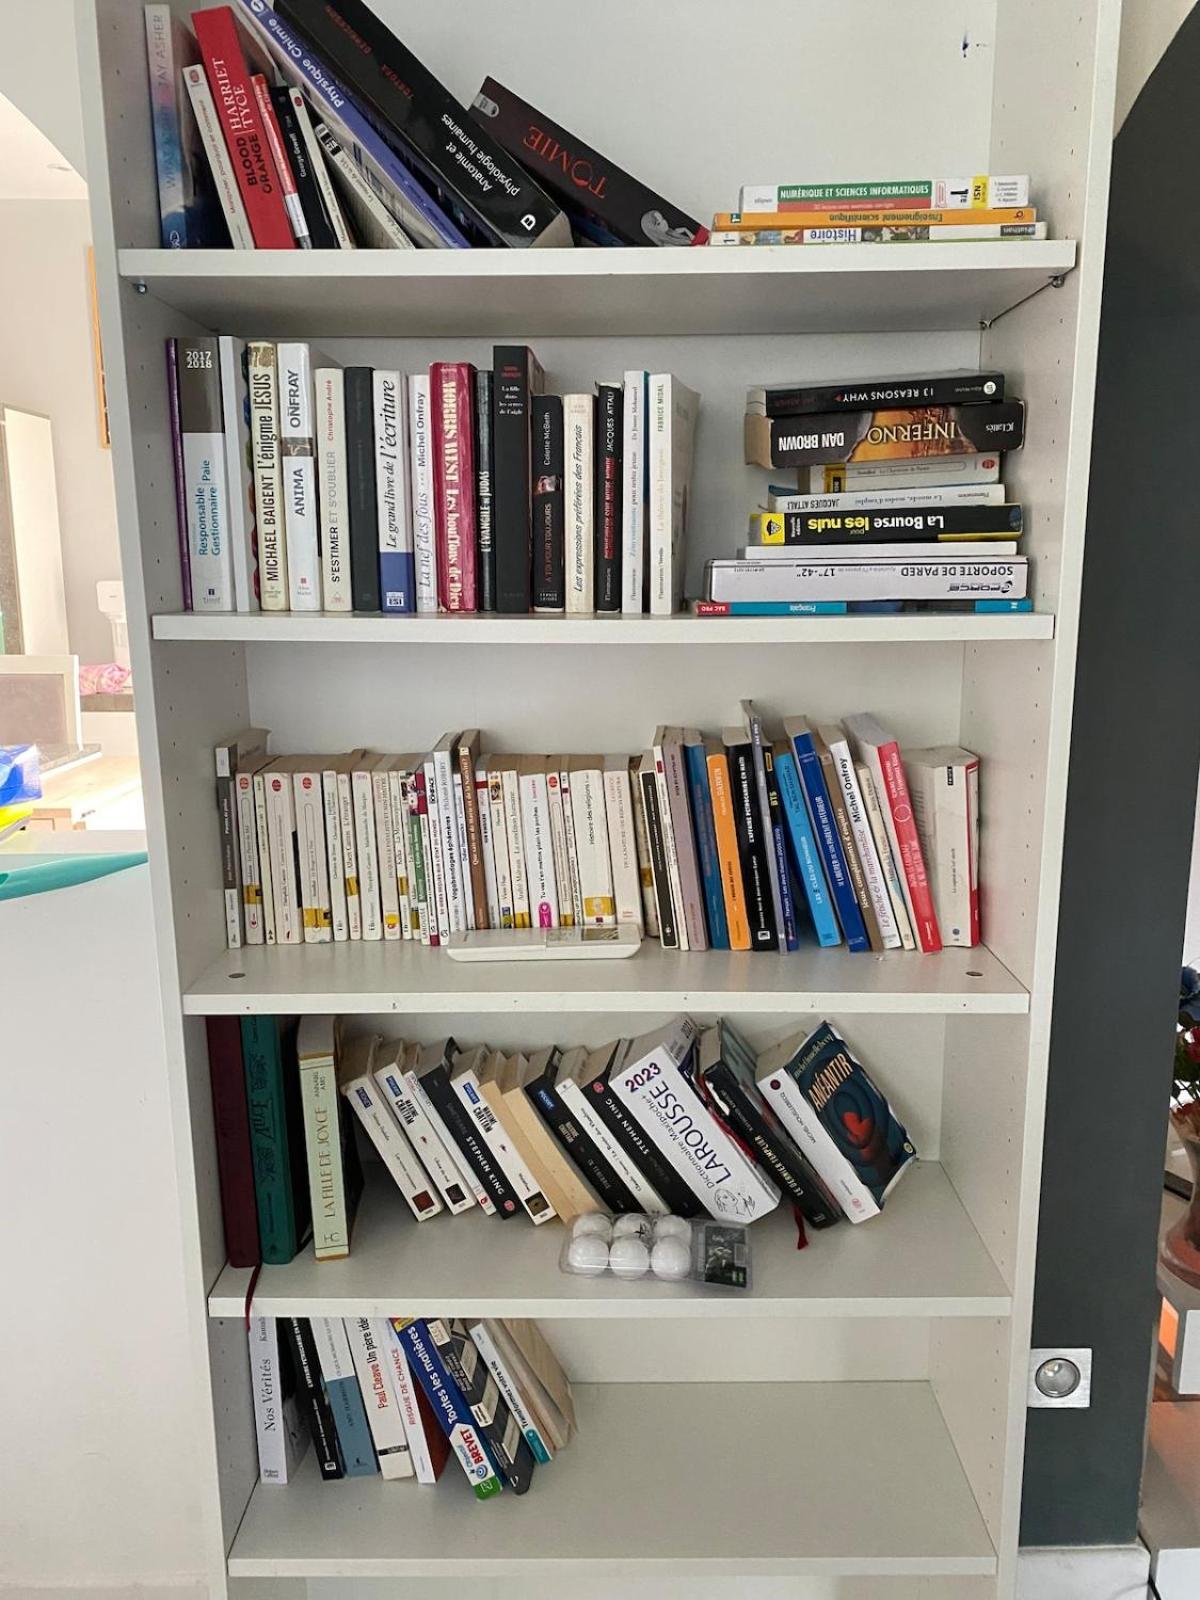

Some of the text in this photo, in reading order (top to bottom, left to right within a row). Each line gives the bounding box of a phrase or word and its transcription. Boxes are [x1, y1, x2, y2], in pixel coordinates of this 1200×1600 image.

[264, 16, 305, 60] Chimie
[156, 65, 168, 88] JAY
[212, 55, 242, 131] HARRIET
[299, 56, 346, 108] Physique
[232, 83, 253, 128] TYCE
[235, 135, 257, 186] BLOOD
[247, 132, 272, 195] ORANGE
[438, 111, 521, 197] physiologie humaines
[444, 140, 493, 192] Anatomie et
[518, 122, 615, 201] TOMIE
[779, 182, 928, 201] NUMÉRIQUE ET SCIENCES INFORMATIQUES
[809, 228, 856, 241] Histoire
[880, 210, 942, 223] Enseignement
[186, 352, 212, 360] 2017
[285, 369, 301, 428] ONFRAY
[842, 386, 934, 401] 13 REASONS WHY
[255, 415, 279, 470] L'énigme
[415, 392, 426, 466] Michel Onfray
[542, 411, 551, 465] Colette McBeth
[606, 418, 614, 452] JACQUES
[777, 431, 845, 450] DAN BROWN
[865, 420, 957, 445] INFERNO
[202, 460, 211, 481] Paie
[379, 380, 398, 548] Le grand livre de l'écriture
[444, 442, 458, 483] WEST
[478, 470, 490, 496] JUDAS
[573, 463, 581, 479] des
[261, 474, 276, 525] BAIGENT
[292, 467, 306, 516] ANIMA
[325, 450, 340, 582] S'ESTIMER ET S'OUBLIER
[571, 481, 584, 523] préférées
[786, 497, 840, 511] JACQUES ATTALI
[195, 487, 206, 556] Responsable
[209, 487, 220, 556] Gestionnaire
[414, 492, 433, 587] La nef des fous
[544, 503, 552, 541] TOUJOURS
[807, 515, 869, 532] les nuls
[873, 514, 944, 530] La Bourse
[264, 529, 279, 581] MICHAEL
[445, 488, 462, 609] Les bouffons de Dieu
[573, 525, 584, 574] expressions
[900, 564, 1014, 576] SOPORTE DE PARED
[573, 576, 583, 591] Les
[769, 790, 778, 806] BTS
[838, 756, 854, 791] Onfray
[585, 809, 593, 820] des
[846, 791, 862, 823] Michel
[587, 821, 595, 844] Histoire
[881, 919, 890, 928] Le
[622, 1060, 663, 1094] 2023
[808, 1052, 854, 1112] ANÉANTIR
[603, 1096, 650, 1156] STEPHEN KING
[647, 1076, 732, 1189] LAROUSSE
[314, 1106, 335, 1217] LA FILLE DE JOYCE
[464, 1134, 505, 1196] STEPHEN KING
[675, 1138, 715, 1191] Dictionnaire
[259, 1358, 275, 1431] Nos Vérités
[361, 1331, 389, 1409] Paul Cleave Un père
[390, 1346, 416, 1426] RISQUE DE CHANCE
[403, 1325, 459, 1425] Toutes les matières
[489, 1358, 529, 1428] Transformez votre vie
[459, 1427, 484, 1465] BREVET
